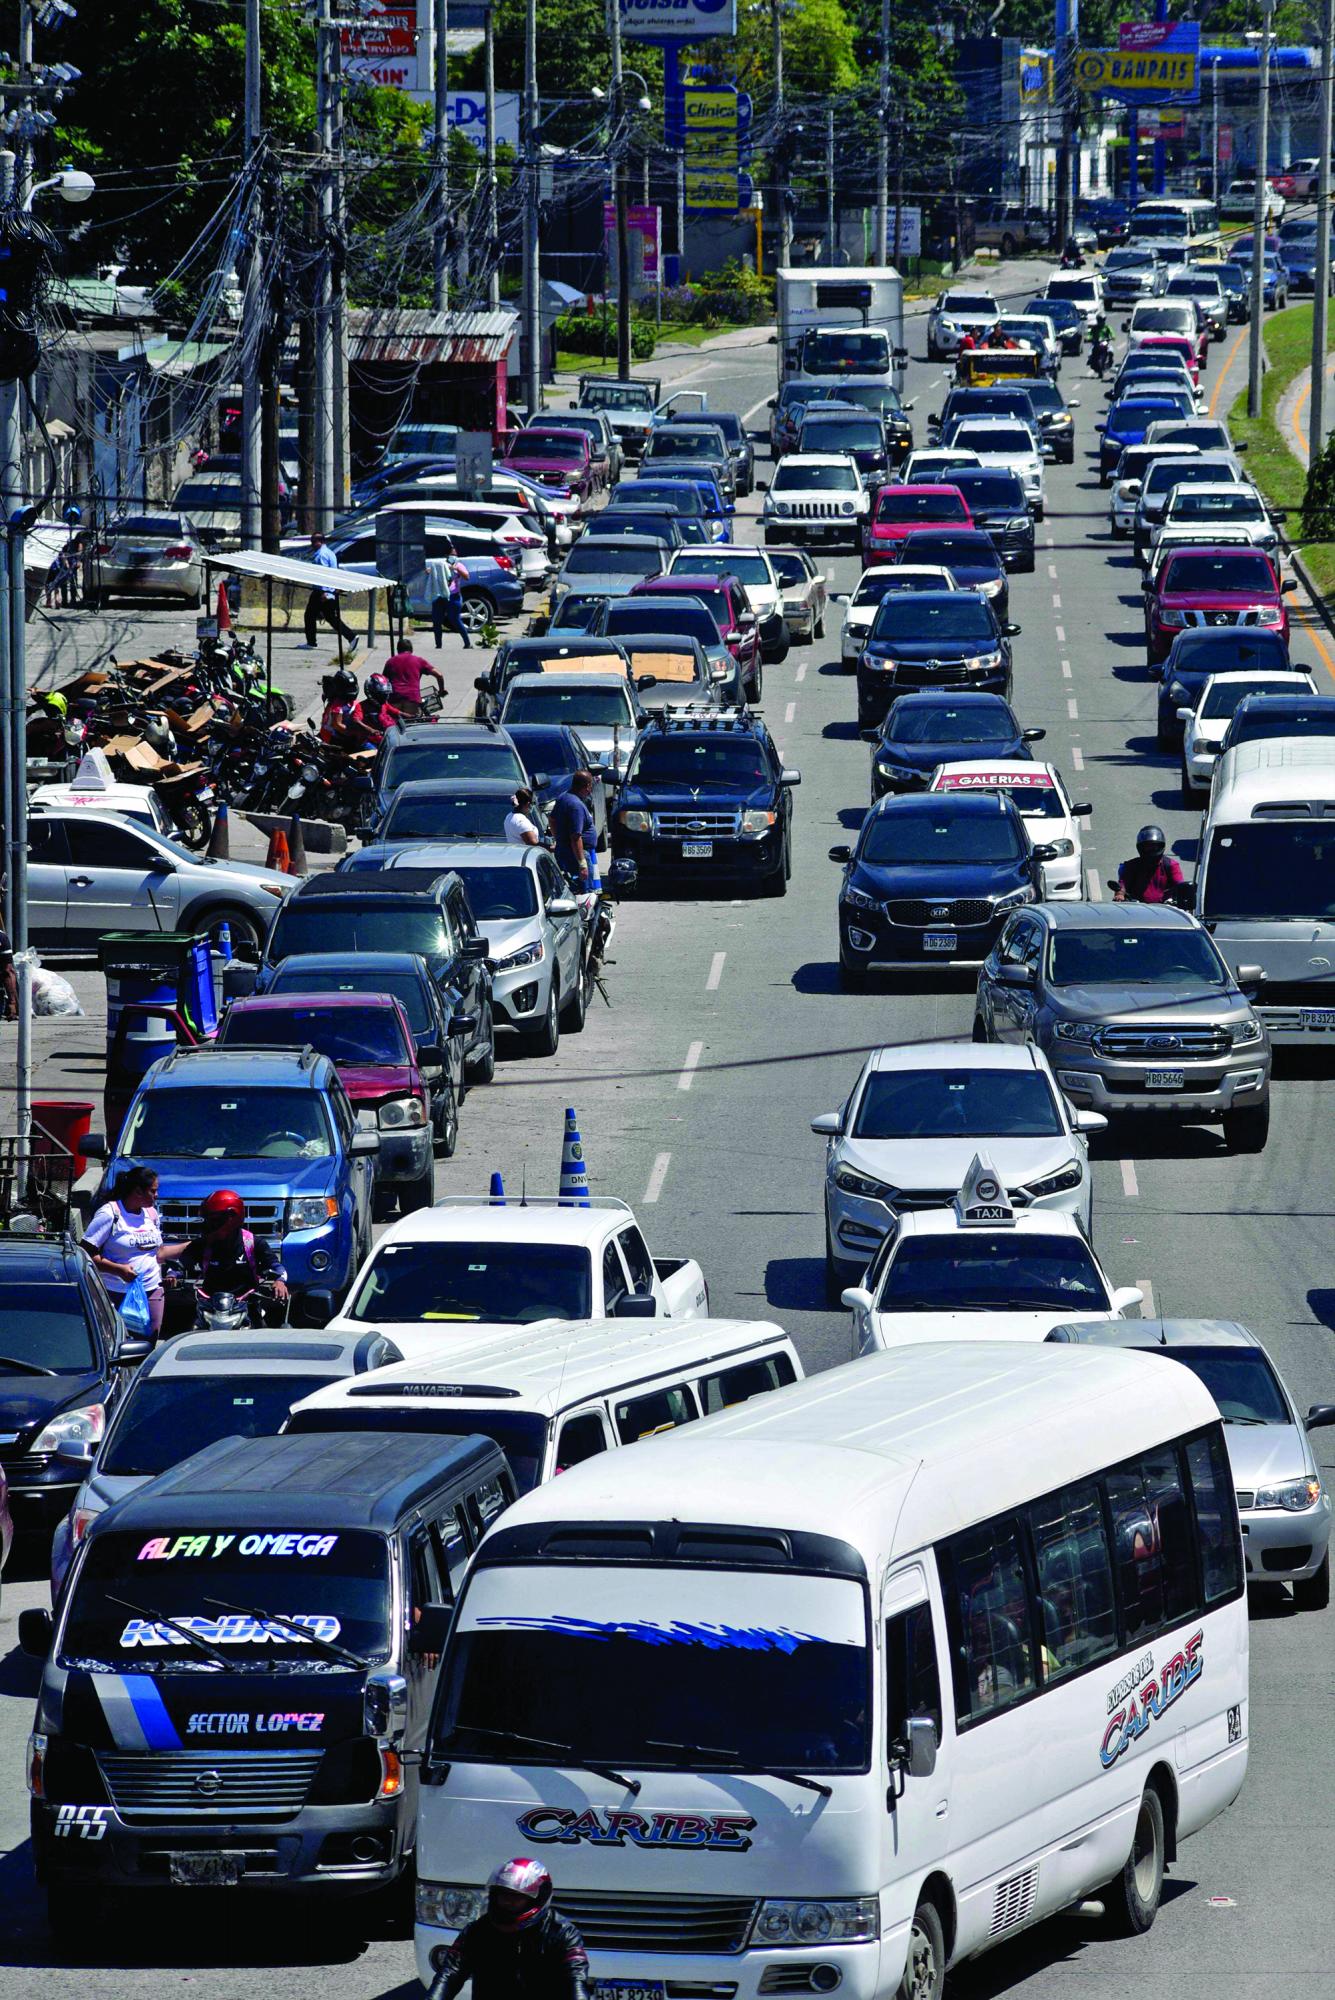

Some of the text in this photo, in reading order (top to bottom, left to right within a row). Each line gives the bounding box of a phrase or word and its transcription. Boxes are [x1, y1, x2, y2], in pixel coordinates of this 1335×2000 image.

[958, 774, 1032, 785] GALERIAS
[974, 1208, 1003, 1218] TAXI
[403, 1385, 464, 1397] NAVARRO
[137, 1534, 340, 1560] ALFA Y OMEGA
[1100, 1628, 1203, 1769] CARIBE
[186, 1712, 325, 1734] SECTOR LOPEZ
[516, 1807, 757, 1852] CARIBE
